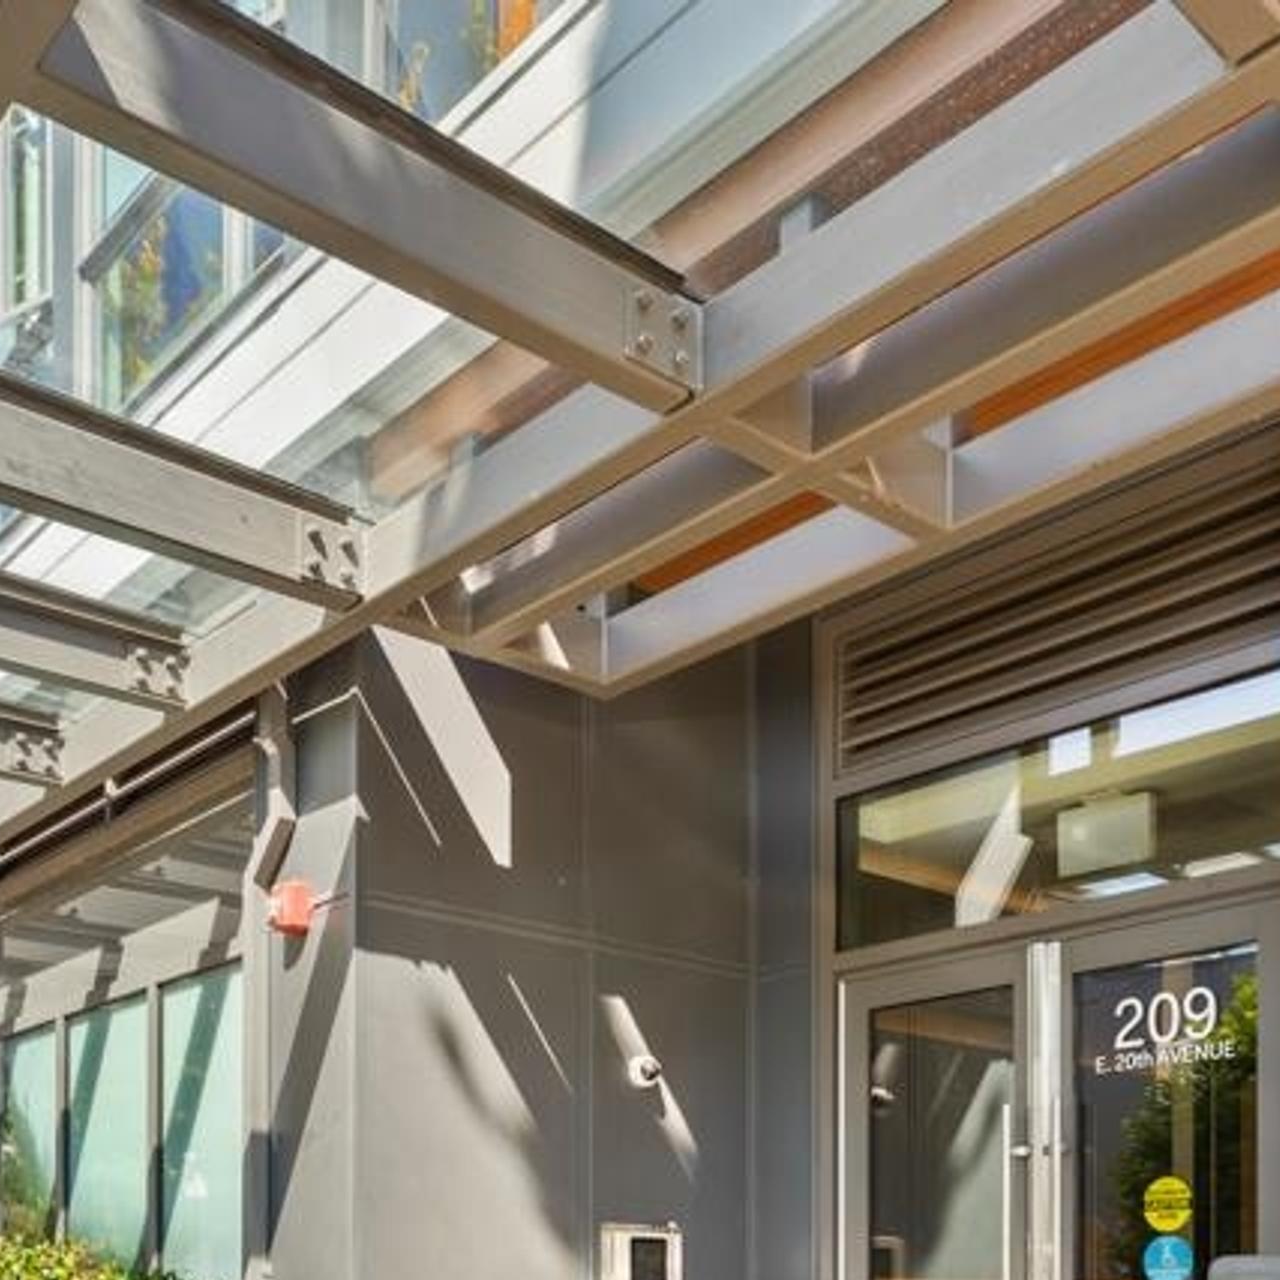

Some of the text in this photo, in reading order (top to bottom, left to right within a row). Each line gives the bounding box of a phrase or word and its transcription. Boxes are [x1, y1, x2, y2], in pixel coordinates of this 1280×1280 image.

[1114, 986, 1217, 1048] 209
[1095, 1039, 1236, 1075] E. 20th AVENUE
